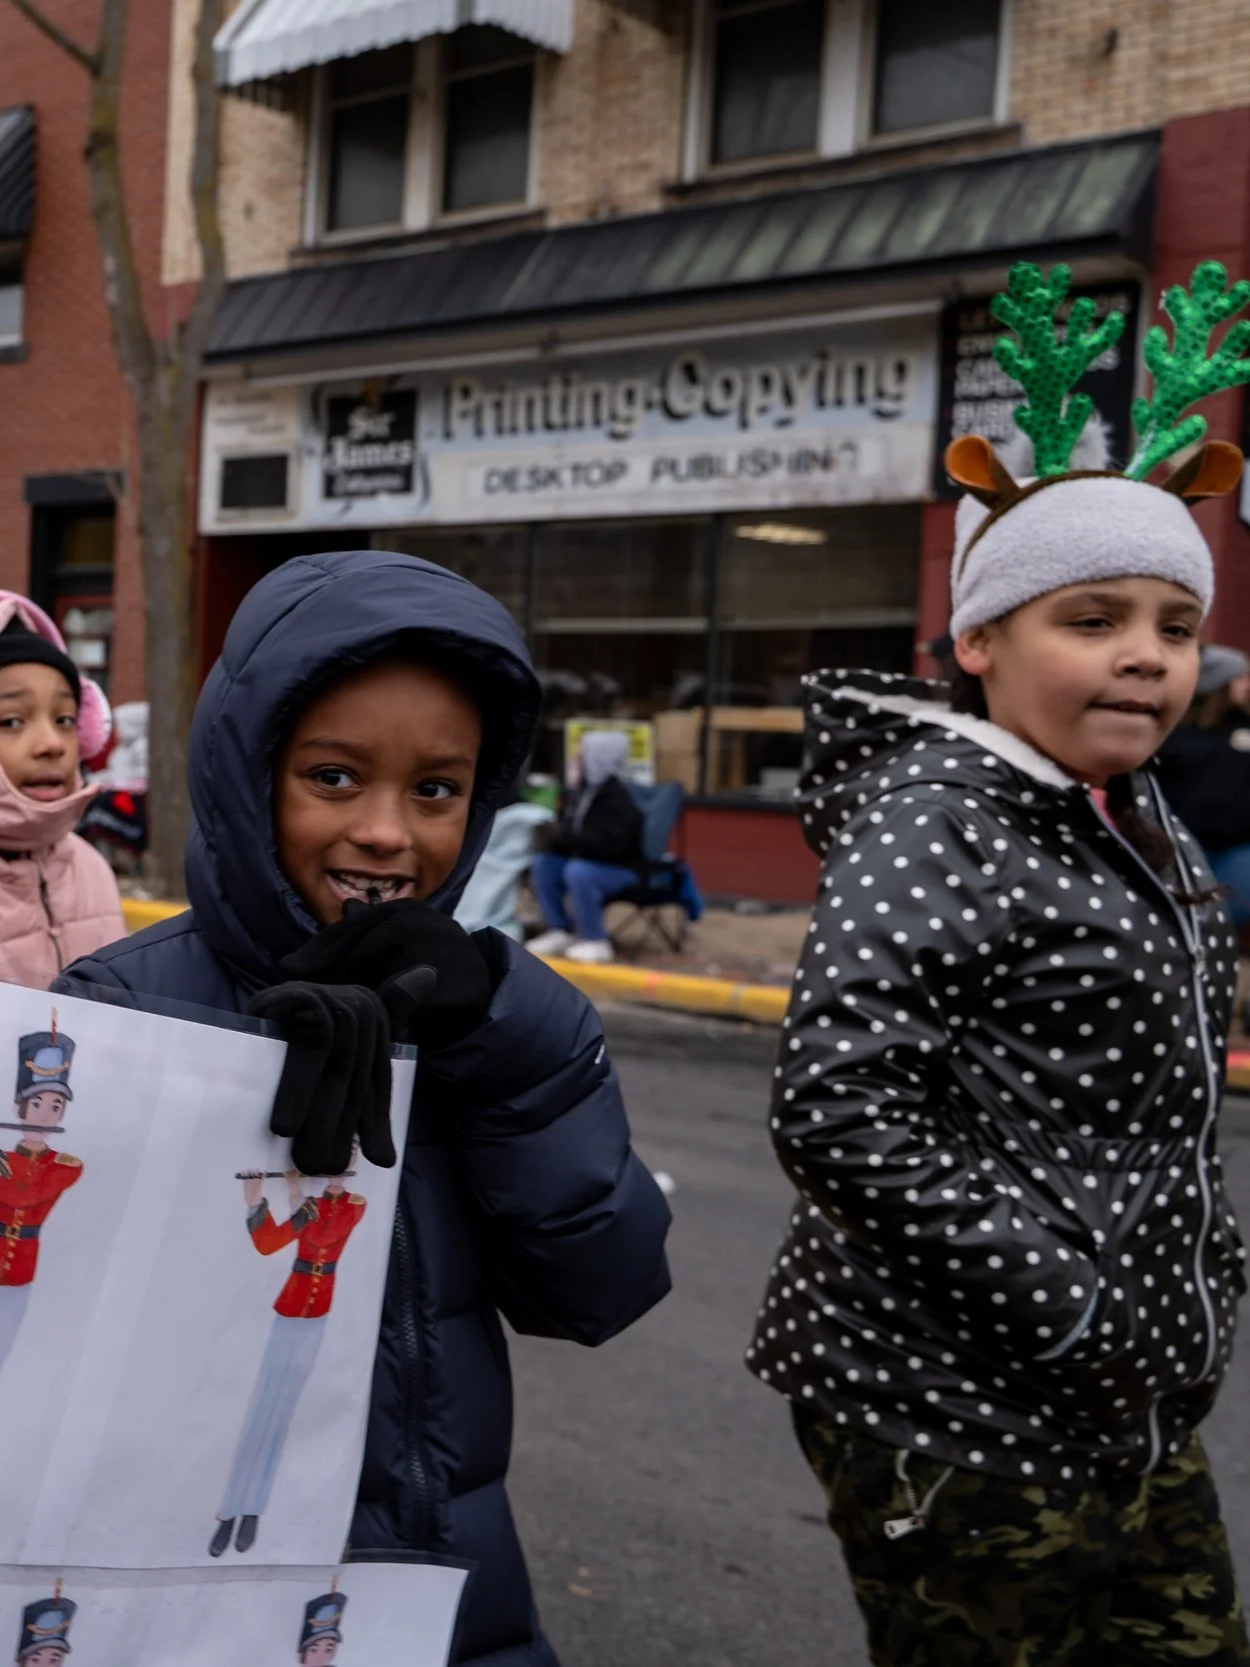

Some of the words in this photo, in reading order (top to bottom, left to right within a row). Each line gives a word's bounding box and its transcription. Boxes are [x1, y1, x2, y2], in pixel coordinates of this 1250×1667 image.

[443, 370, 647, 440] Printing
[660, 344, 917, 431] Copying
[483, 457, 629, 495] DESKTOP
